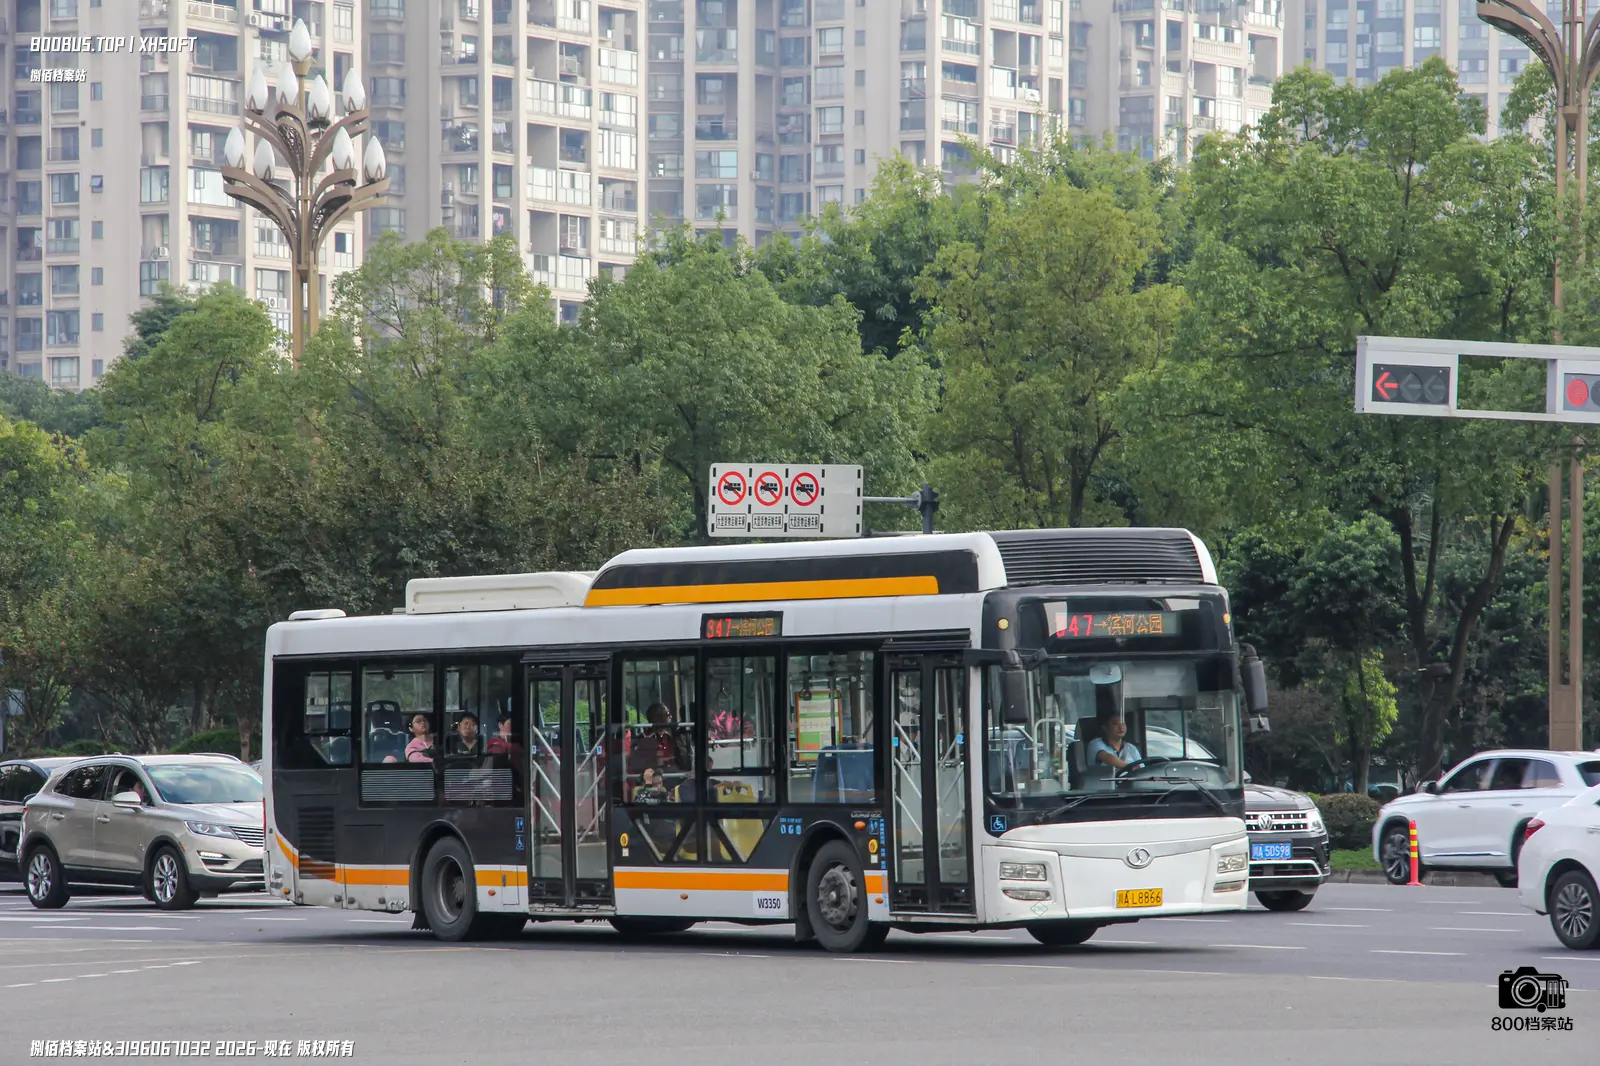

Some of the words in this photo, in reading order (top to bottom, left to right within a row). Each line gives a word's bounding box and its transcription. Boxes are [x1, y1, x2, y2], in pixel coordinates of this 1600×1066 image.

[1107, 613, 1163, 636] 滨河公园
[757, 897, 781, 909] W3350
